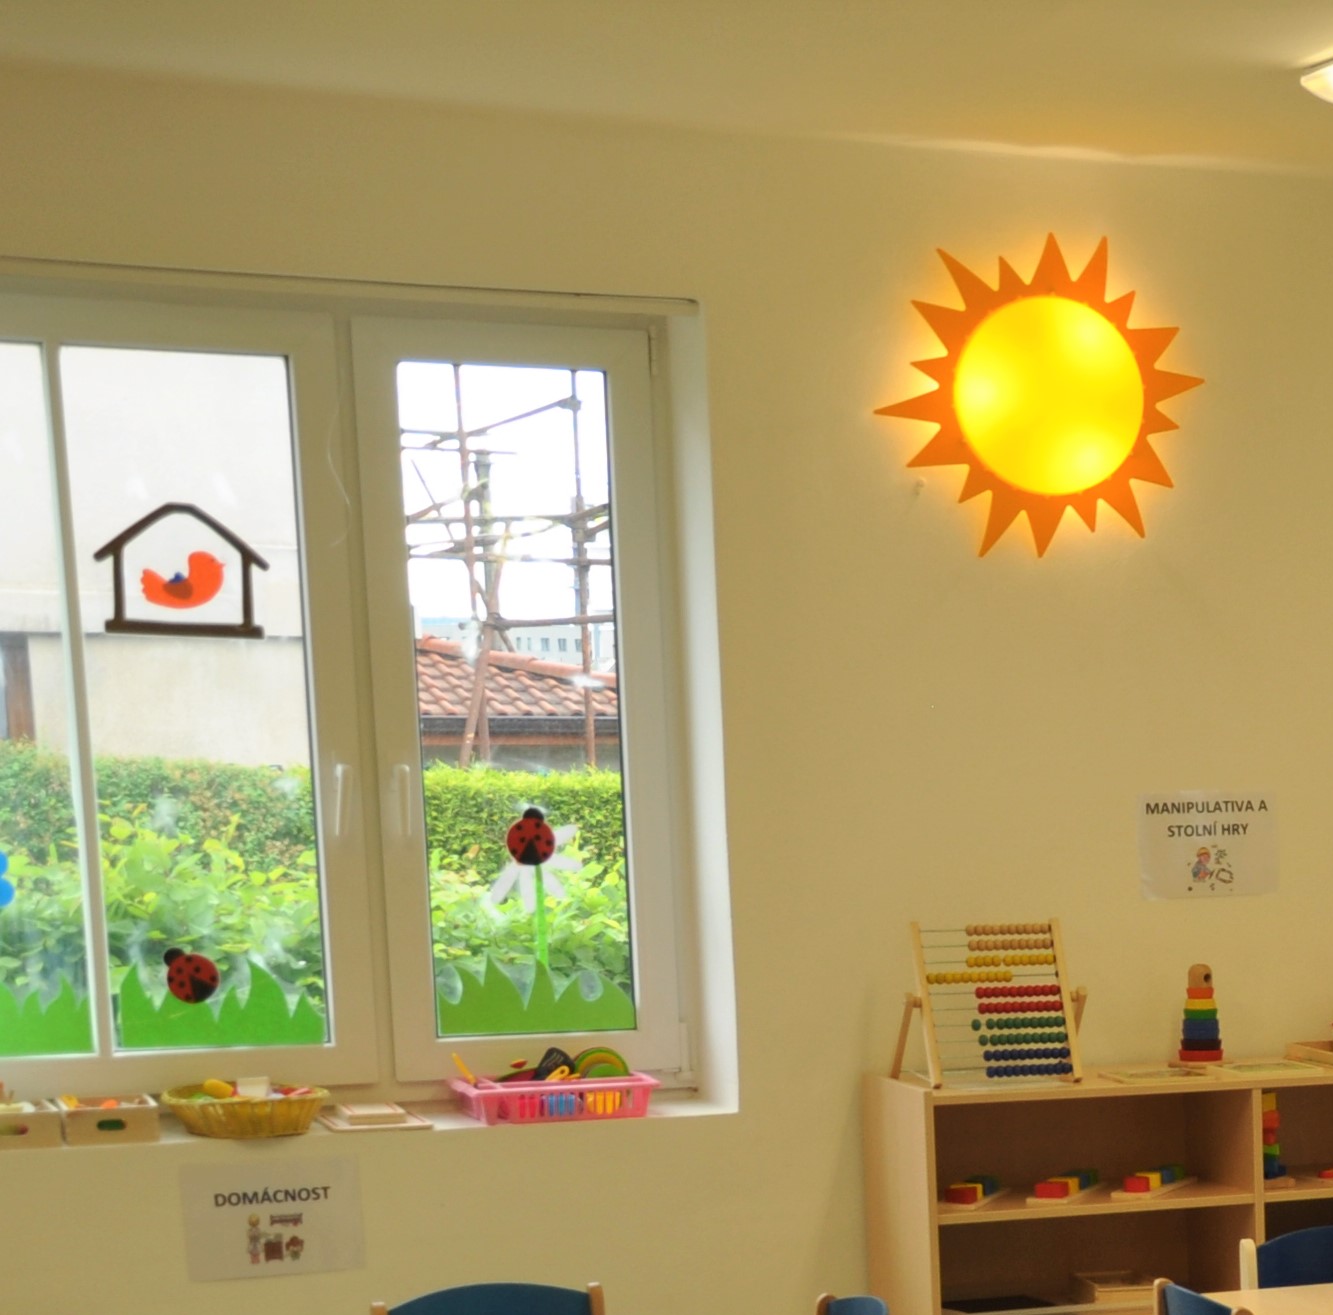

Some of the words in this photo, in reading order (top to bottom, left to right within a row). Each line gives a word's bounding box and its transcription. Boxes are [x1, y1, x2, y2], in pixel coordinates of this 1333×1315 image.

[1145, 800, 1255, 815] MANIPULATIVA
[1258, 799, 1269, 812] A
[1167, 821, 1218, 838] STOLNÍ
[1221, 823, 1249, 836] HRY
[213, 1186, 331, 1208] DOMÁCNOST
